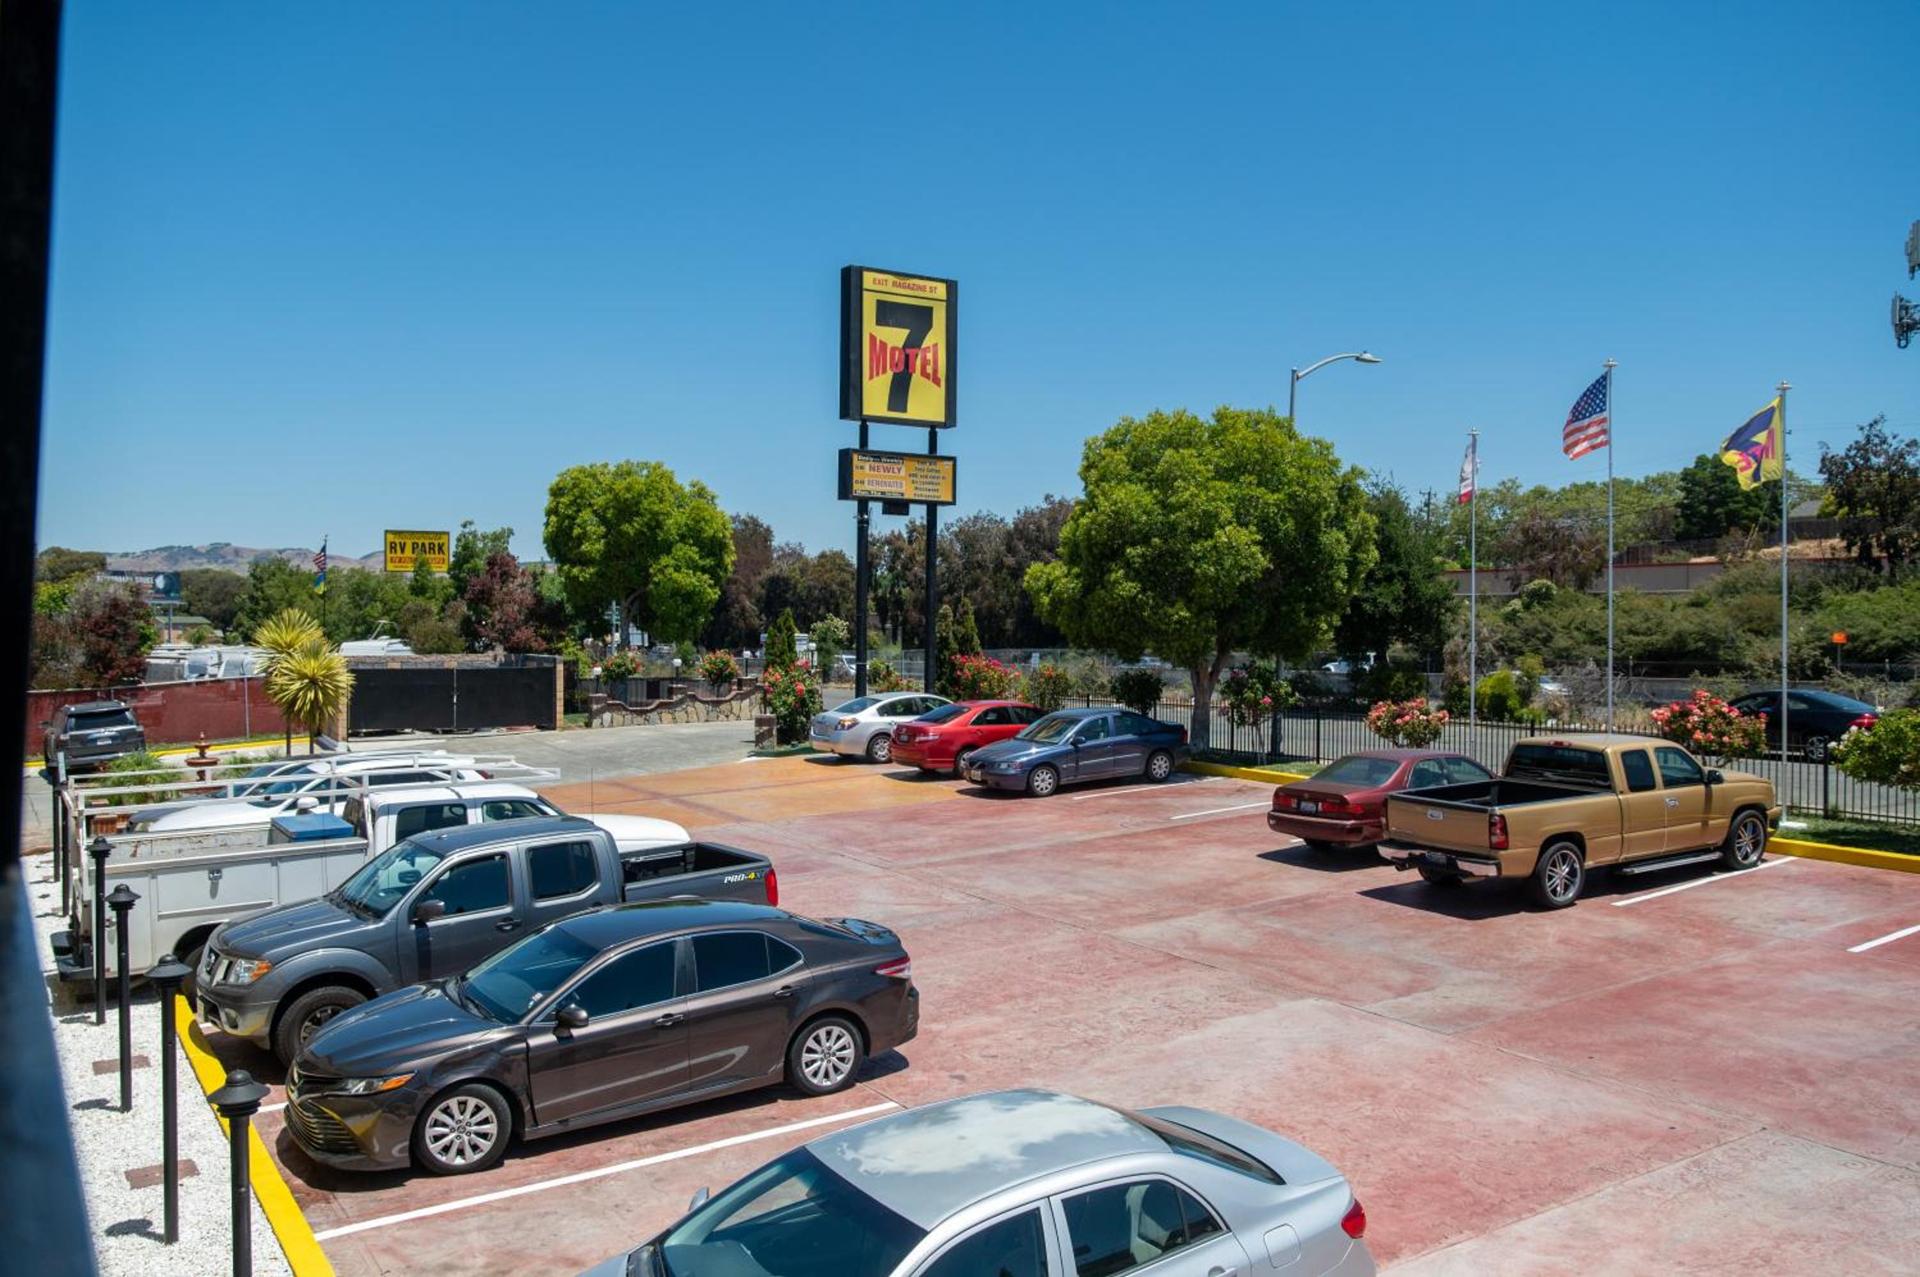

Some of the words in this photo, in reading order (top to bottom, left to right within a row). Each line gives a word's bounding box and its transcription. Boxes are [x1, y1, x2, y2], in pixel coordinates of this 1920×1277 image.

[872, 277, 888, 287] EXIT
[891, 280, 927, 293] MAGAZINE
[929, 285, 938, 295] ST
[868, 332, 942, 388] MOTEL
[876, 299, 934, 413] 7
[868, 463, 903, 475] NEWLY
[390, 542, 406, 554] RV
[412, 542, 446, 555] PARK
